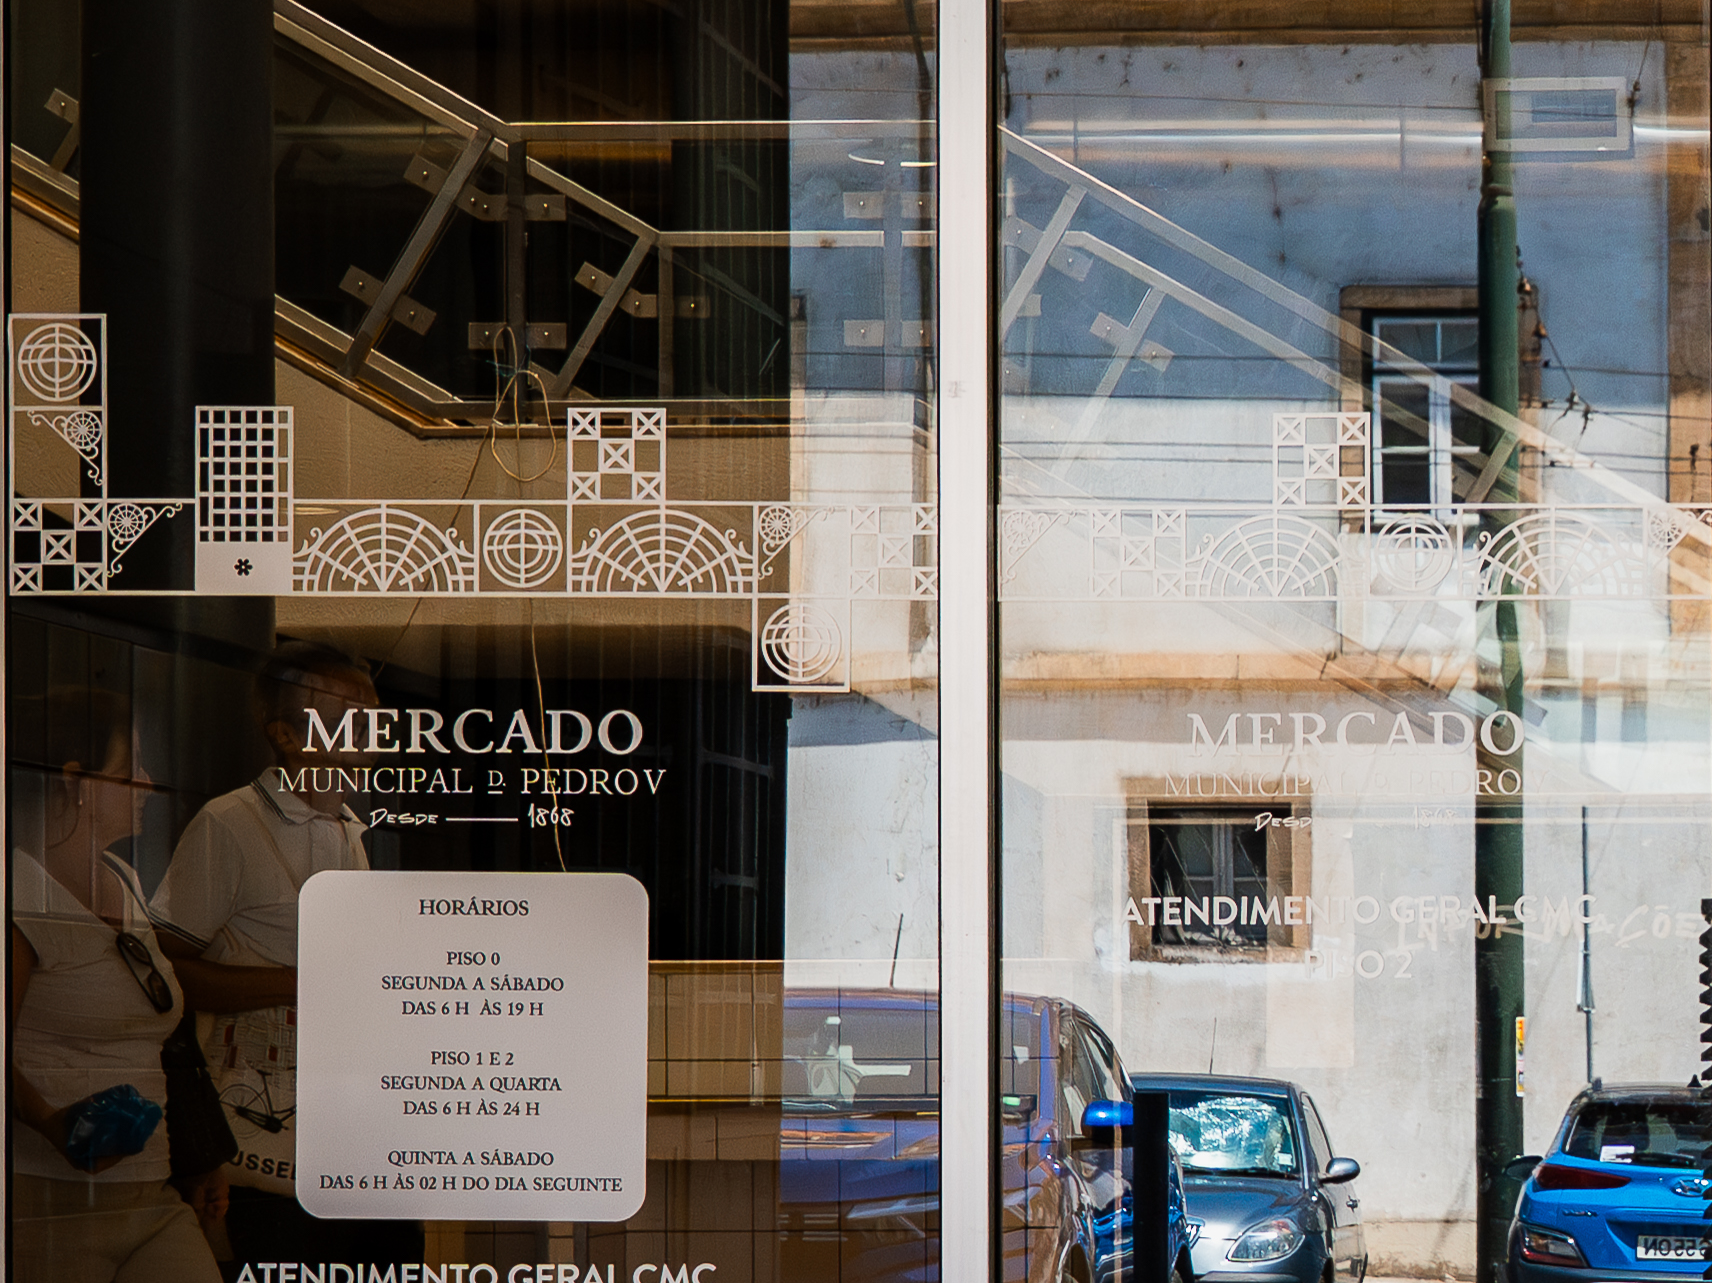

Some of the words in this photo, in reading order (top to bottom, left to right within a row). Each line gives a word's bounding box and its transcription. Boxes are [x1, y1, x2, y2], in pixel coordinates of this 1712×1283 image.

[301, 702, 643, 756] MERCADO
[1187, 710, 1526, 757] MERCADO
[277, 766, 473, 794] MUNICIPAL
[520, 767, 639, 796] PEDRO
[643, 768, 667, 795] V
[527, 803, 575, 829] 1868
[419, 896, 529, 917] HORÁRIOS
[1122, 895, 1381, 926] ATENDIMENTO
[1390, 894, 1507, 924] GERAL
[1514, 894, 1597, 924] CMC
[446, 951, 487, 966] PISO
[490, 952, 501, 966] 0
[1304, 949, 1385, 980] PISO
[1394, 949, 1413, 980] 2
[381, 975, 468, 991] SEGUNDA
[472, 976, 486, 991] A
[490, 973, 565, 992] SÁBADO
[401, 1000, 437, 1015] DAS
[441, 1001, 450, 1015] 6
[455, 1001, 469, 1016] H
[479, 998, 502, 1016] ÀS
[508, 1002, 525, 1016] 19
[529, 1001, 544, 1016] H
[430, 1050, 471, 1066] PISO
[476, 1051, 483, 1066] 1
[489, 1051, 501, 1066] E
[504, 1052, 514, 1066] 2
[380, 1075, 467, 1091] SEGUNDA
[471, 1076, 485, 1091] A
[489, 1076, 562, 1094] QUARTA
[403, 1100, 438, 1115] DAS
[442, 1101, 452, 1115] 6
[456, 1101, 471, 1116] H
[476, 1098, 499, 1116] ÀS
[503, 1101, 520, 1116] 24
[525, 1101, 540, 1116] H
[230, 1150, 296, 1180] USSE
[387, 1150, 458, 1168] QUINTA
[462, 1151, 476, 1166] A
[480, 1148, 555, 1166] SÁBADO
[319, 1174, 355, 1190] DAS
[358, 1175, 369, 1190] 6
[372, 1175, 388, 1190] H
[392, 1172, 415, 1190] ÀS
[419, 1176, 437, 1190] 02
[442, 1176, 457, 1191] H
[462, 1176, 490, 1191] DO
[495, 1176, 528, 1191] DIA
[533, 1177, 623, 1192] SEGUINTE
